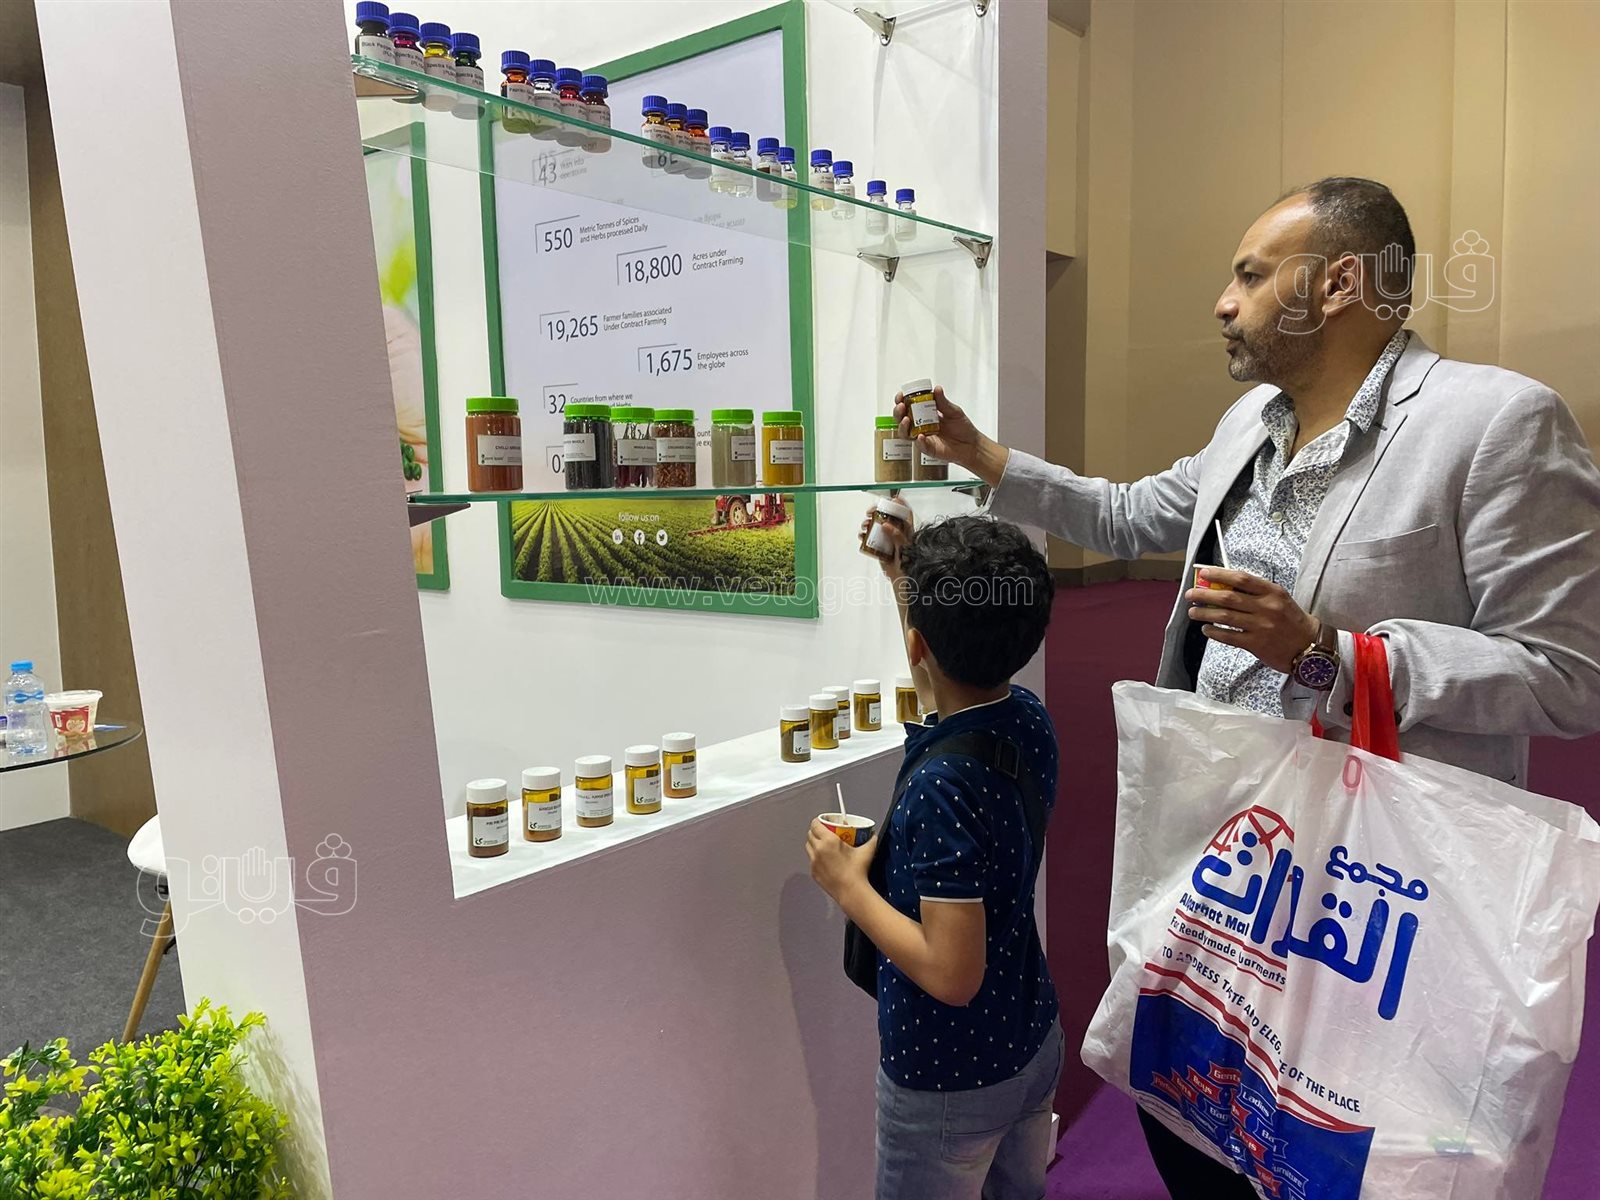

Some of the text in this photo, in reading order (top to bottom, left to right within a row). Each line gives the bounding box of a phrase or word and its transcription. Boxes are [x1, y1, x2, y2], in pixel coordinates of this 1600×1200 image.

[579, 225, 597, 234] Metric
[597, 222, 615, 231] Tonnes
[622, 216, 640, 226] Spices
[580, 223, 649, 243] and Herbs processed Daily
[544, 226, 573, 253] 550
[692, 248, 727, 261] Acres under
[692, 256, 744, 271] Contract Farming
[624, 253, 682, 284] 18,800
[603, 305, 673, 322] Farmer families associated
[603, 316, 668, 332] Under Contract Farming
[547, 314, 598, 342] 19,265
[646, 348, 692, 377] 1,675
[697, 349, 749, 361] Employees across
[697, 360, 726, 371] the globe
[548, 393, 566, 415] 32
[570, 396, 594, 404] Countries
[594, 393, 608, 403] from
[608, 392, 625, 402] where
[618, 510, 660, 522] follow us on
[1324, 844, 1430, 902] مجمع
[1180, 924, 1237, 958] Readymade
[1162, 945, 1173, 959] TO
[1288, 1066, 1305, 1083] OF
[1306, 1076, 1326, 1098] THE
[1327, 1089, 1361, 1113] PLACE
[1242, 1090, 1270, 1118] Ladies
[1271, 1163, 1304, 1188] urniture
